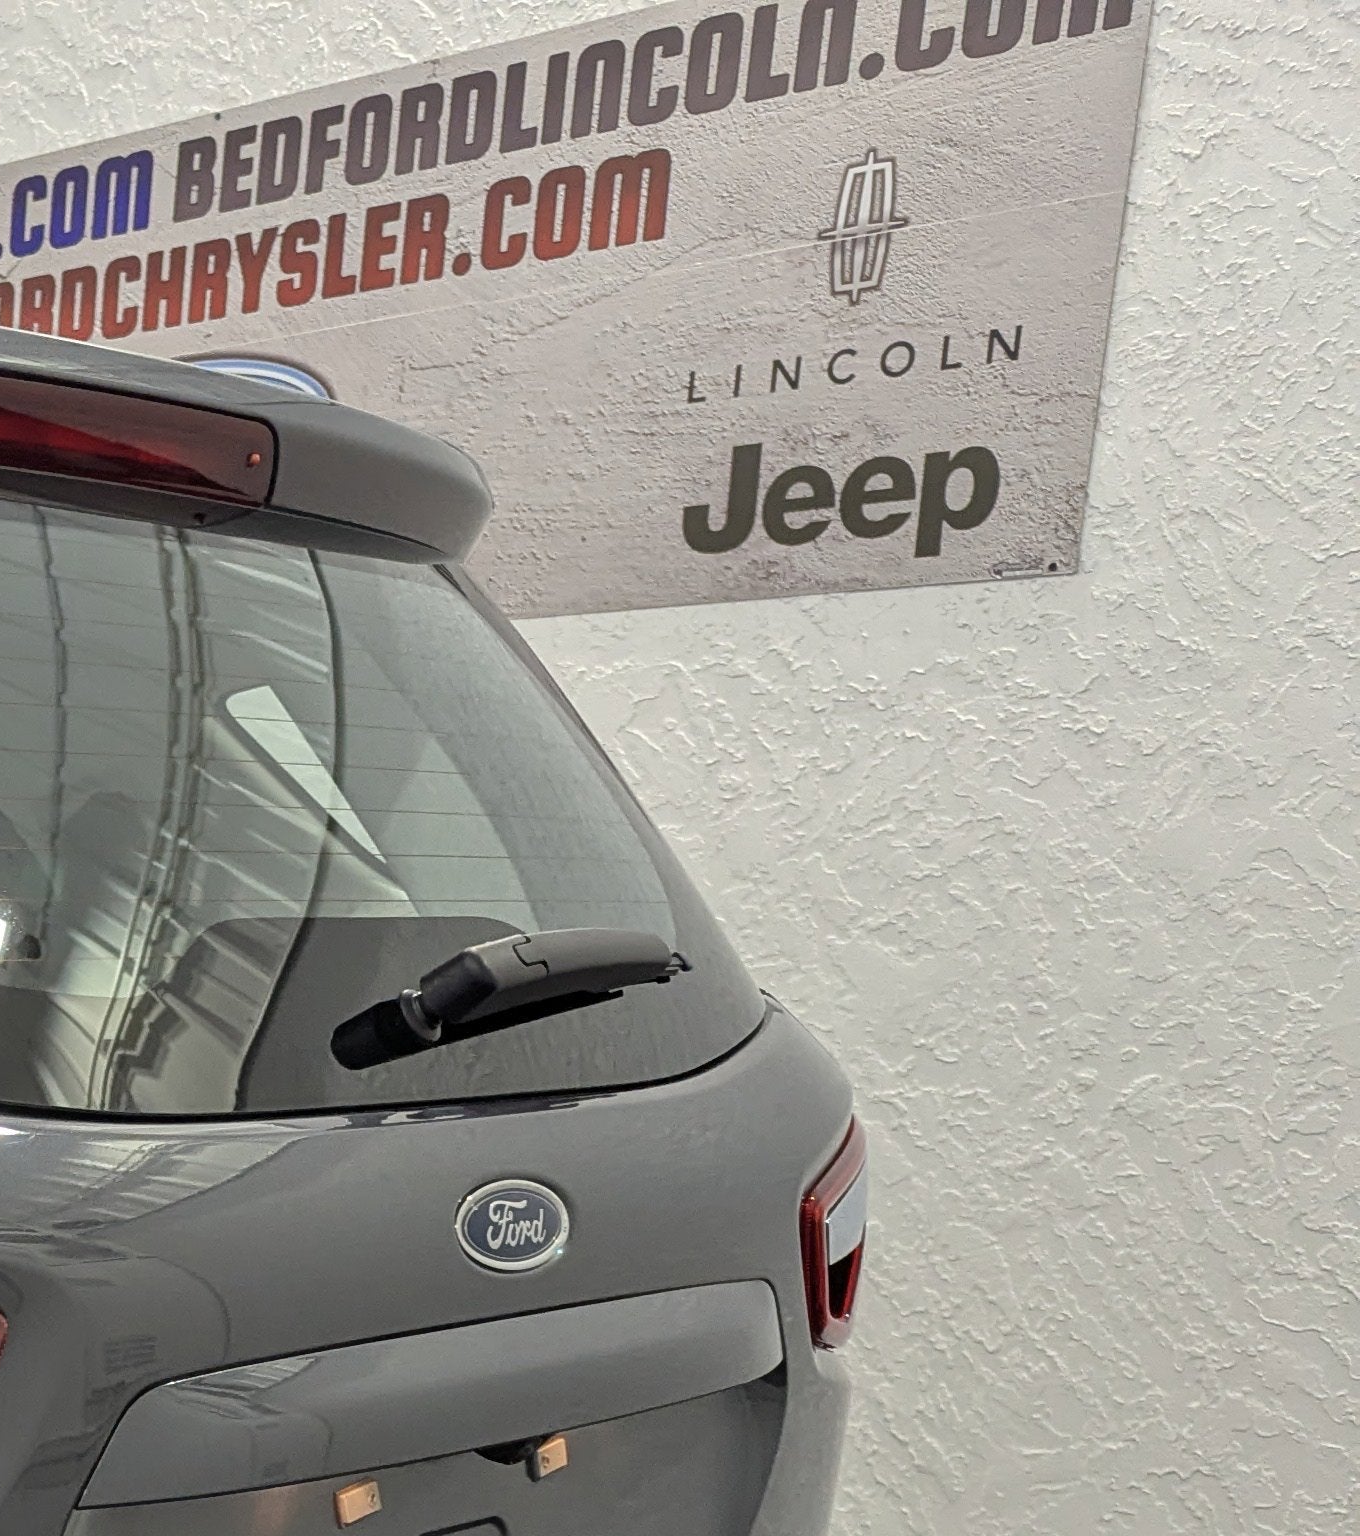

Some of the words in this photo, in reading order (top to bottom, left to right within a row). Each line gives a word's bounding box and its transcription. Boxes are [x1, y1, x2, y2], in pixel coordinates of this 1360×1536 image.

[686, 325, 1023, 403] LINCOLN
[682, 443, 1001, 558] Jeep
[486, 1199, 547, 1250] Ford
